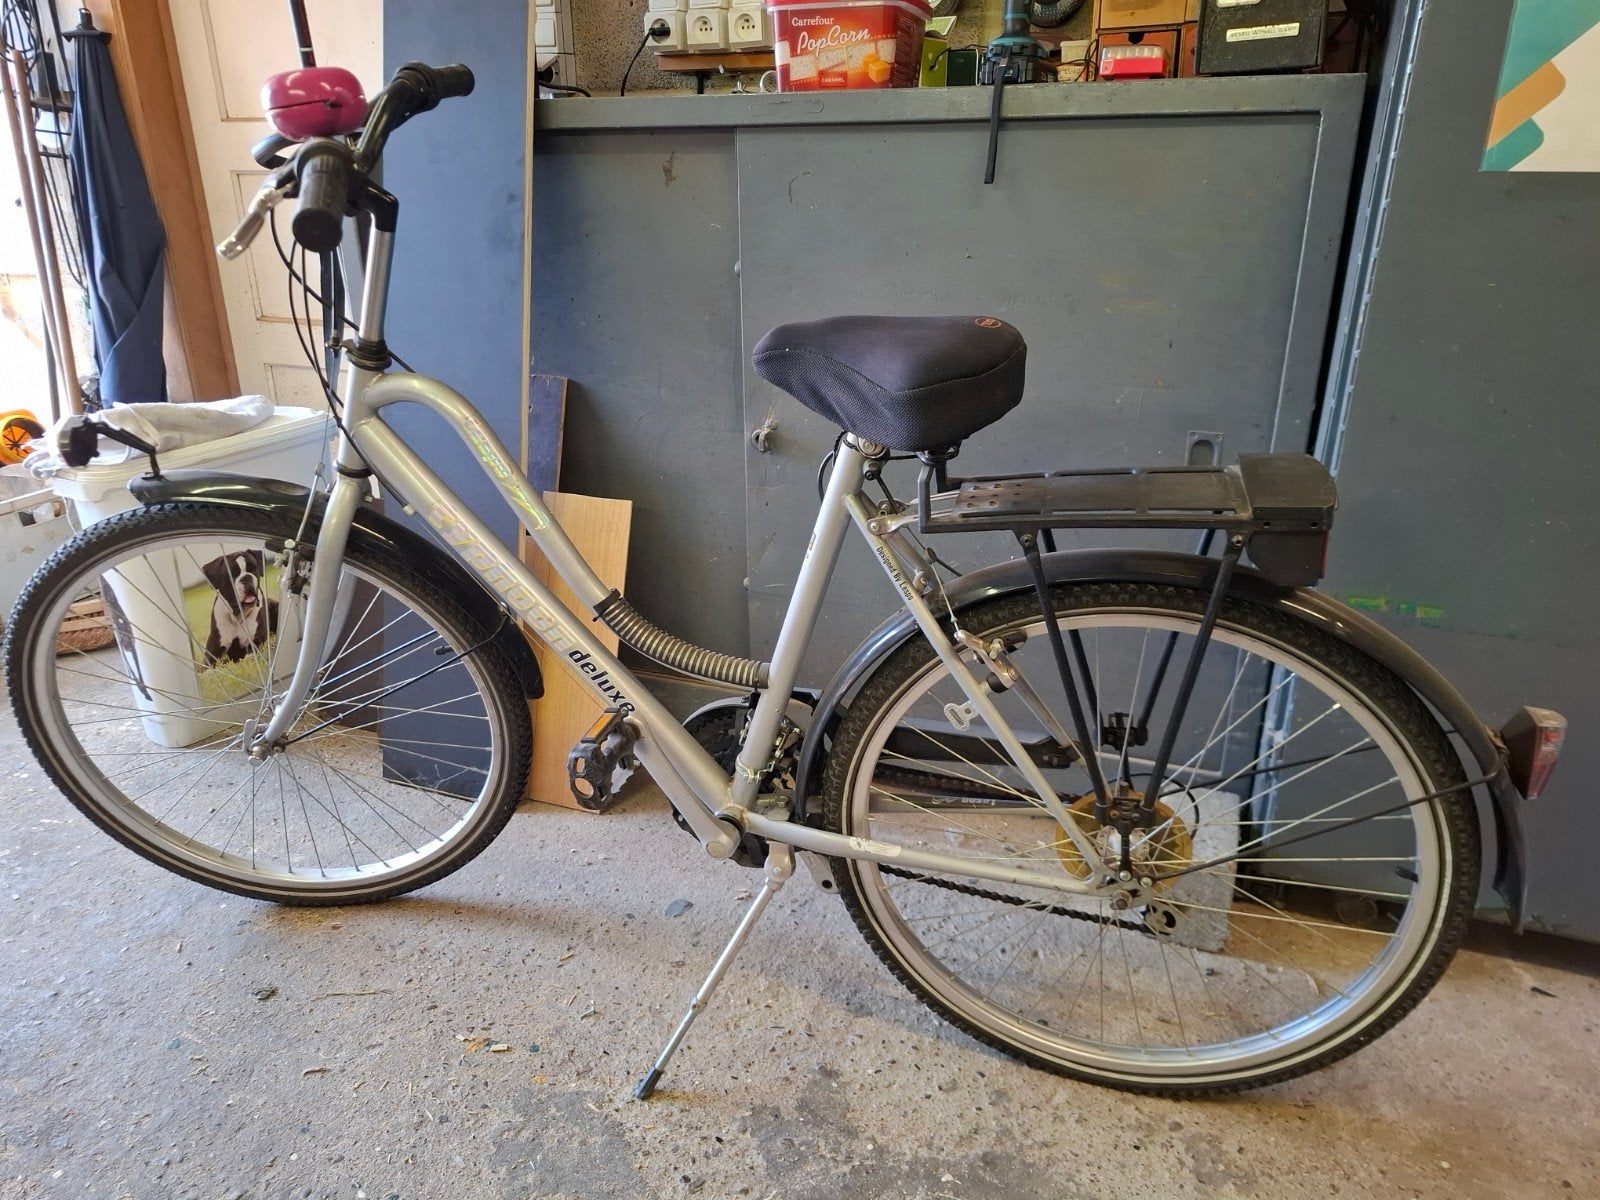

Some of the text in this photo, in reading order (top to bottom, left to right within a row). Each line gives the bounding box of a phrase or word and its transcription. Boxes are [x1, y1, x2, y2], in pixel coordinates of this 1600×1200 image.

[792, 16, 834, 26] Carrefour
[798, 25, 871, 58] PopCorn
[876, 546, 914, 601] Designed By Lespo
[568, 649, 636, 714] deluxe
